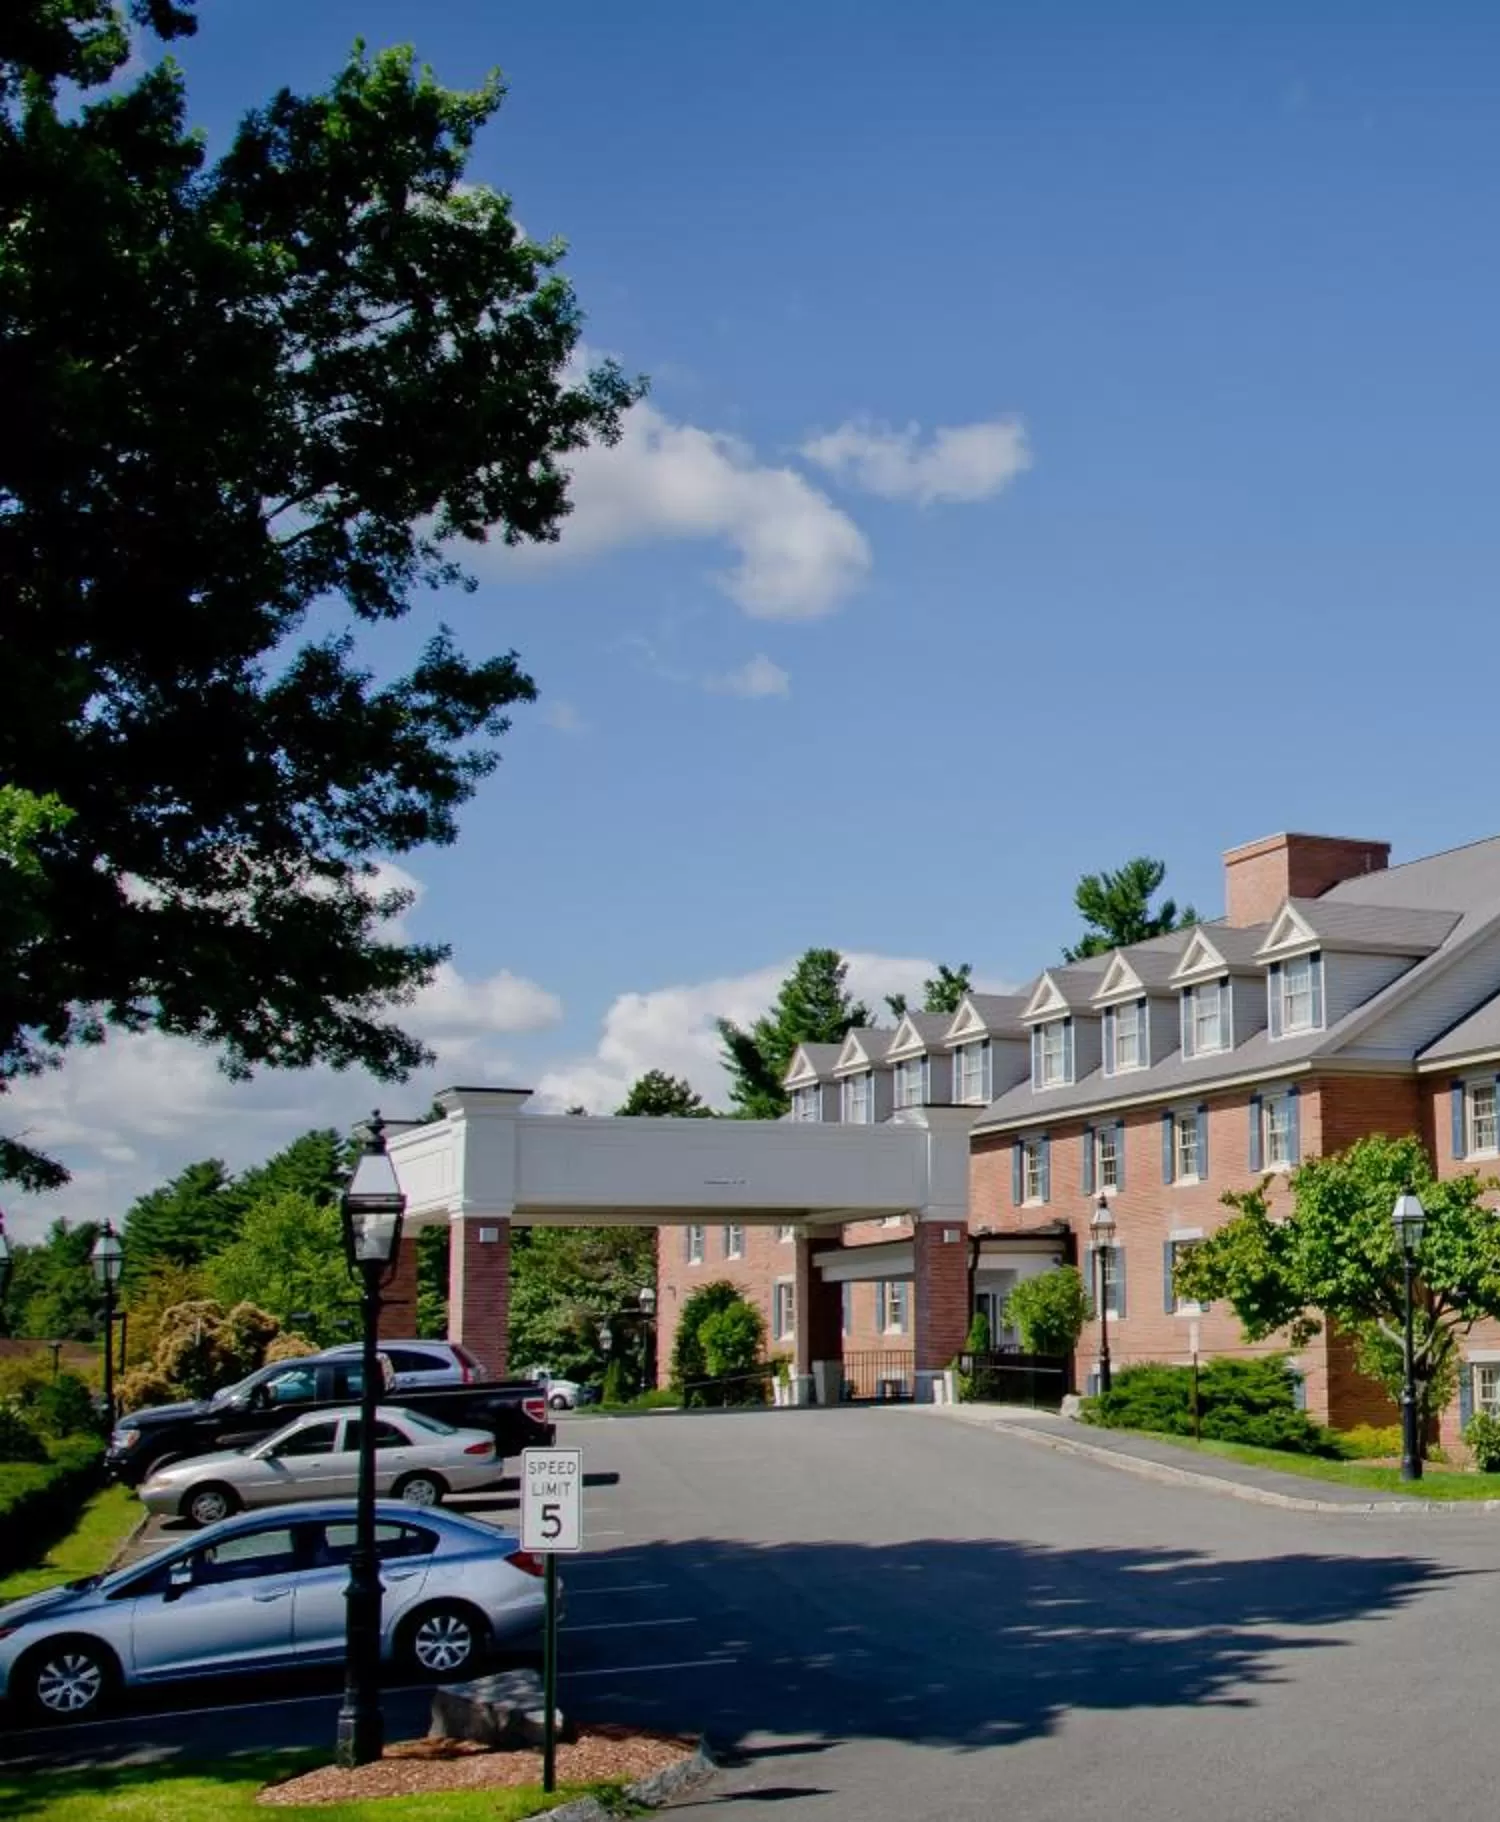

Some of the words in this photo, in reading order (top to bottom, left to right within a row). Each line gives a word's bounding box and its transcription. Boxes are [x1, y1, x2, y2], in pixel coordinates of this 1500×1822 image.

[527, 1461, 577, 1475] SPEED
[531, 1482, 571, 1496] LIMIT
[540, 1503, 562, 1539] 5
